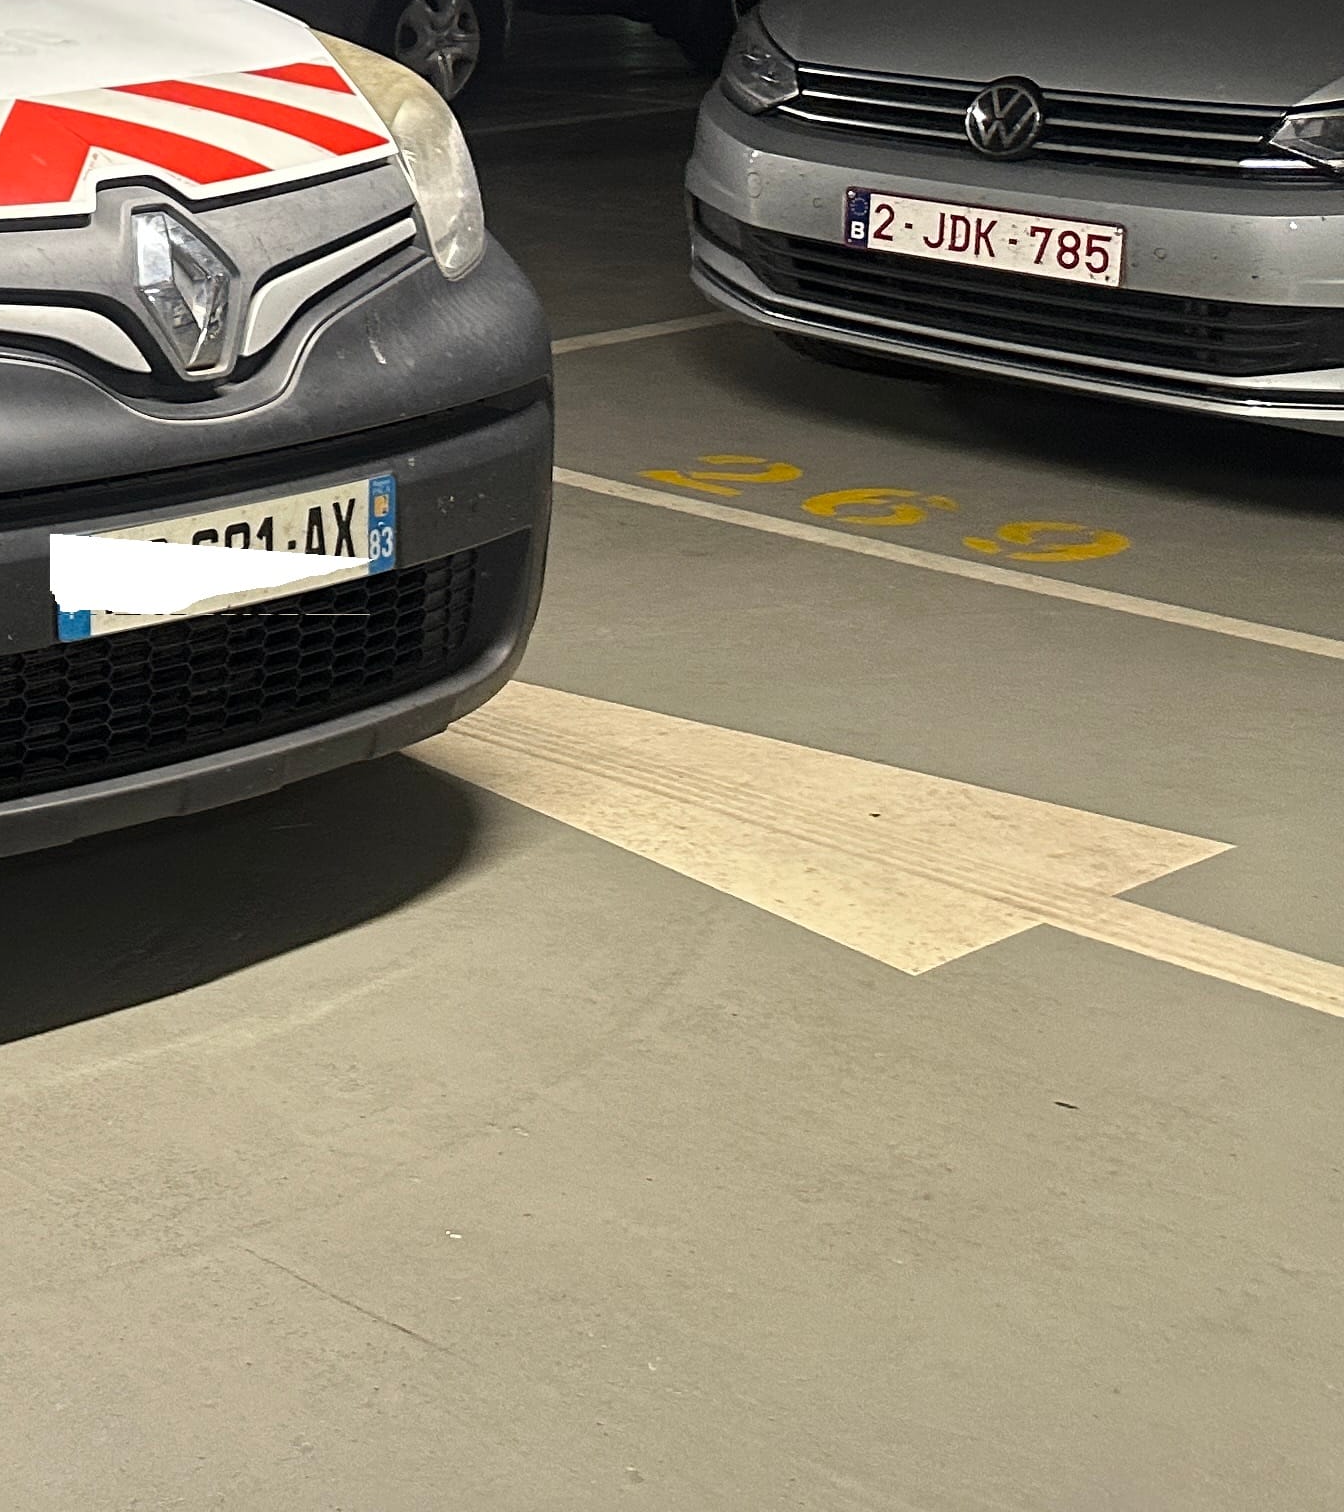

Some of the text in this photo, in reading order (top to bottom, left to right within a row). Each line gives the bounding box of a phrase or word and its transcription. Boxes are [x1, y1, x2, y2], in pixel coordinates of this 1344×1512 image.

[850, 221, 865, 239] B
[873, 204, 1112, 274] 2-JDK-785
[639, 454, 1131, 561] 269
[369, 527, 393, 560] 83
